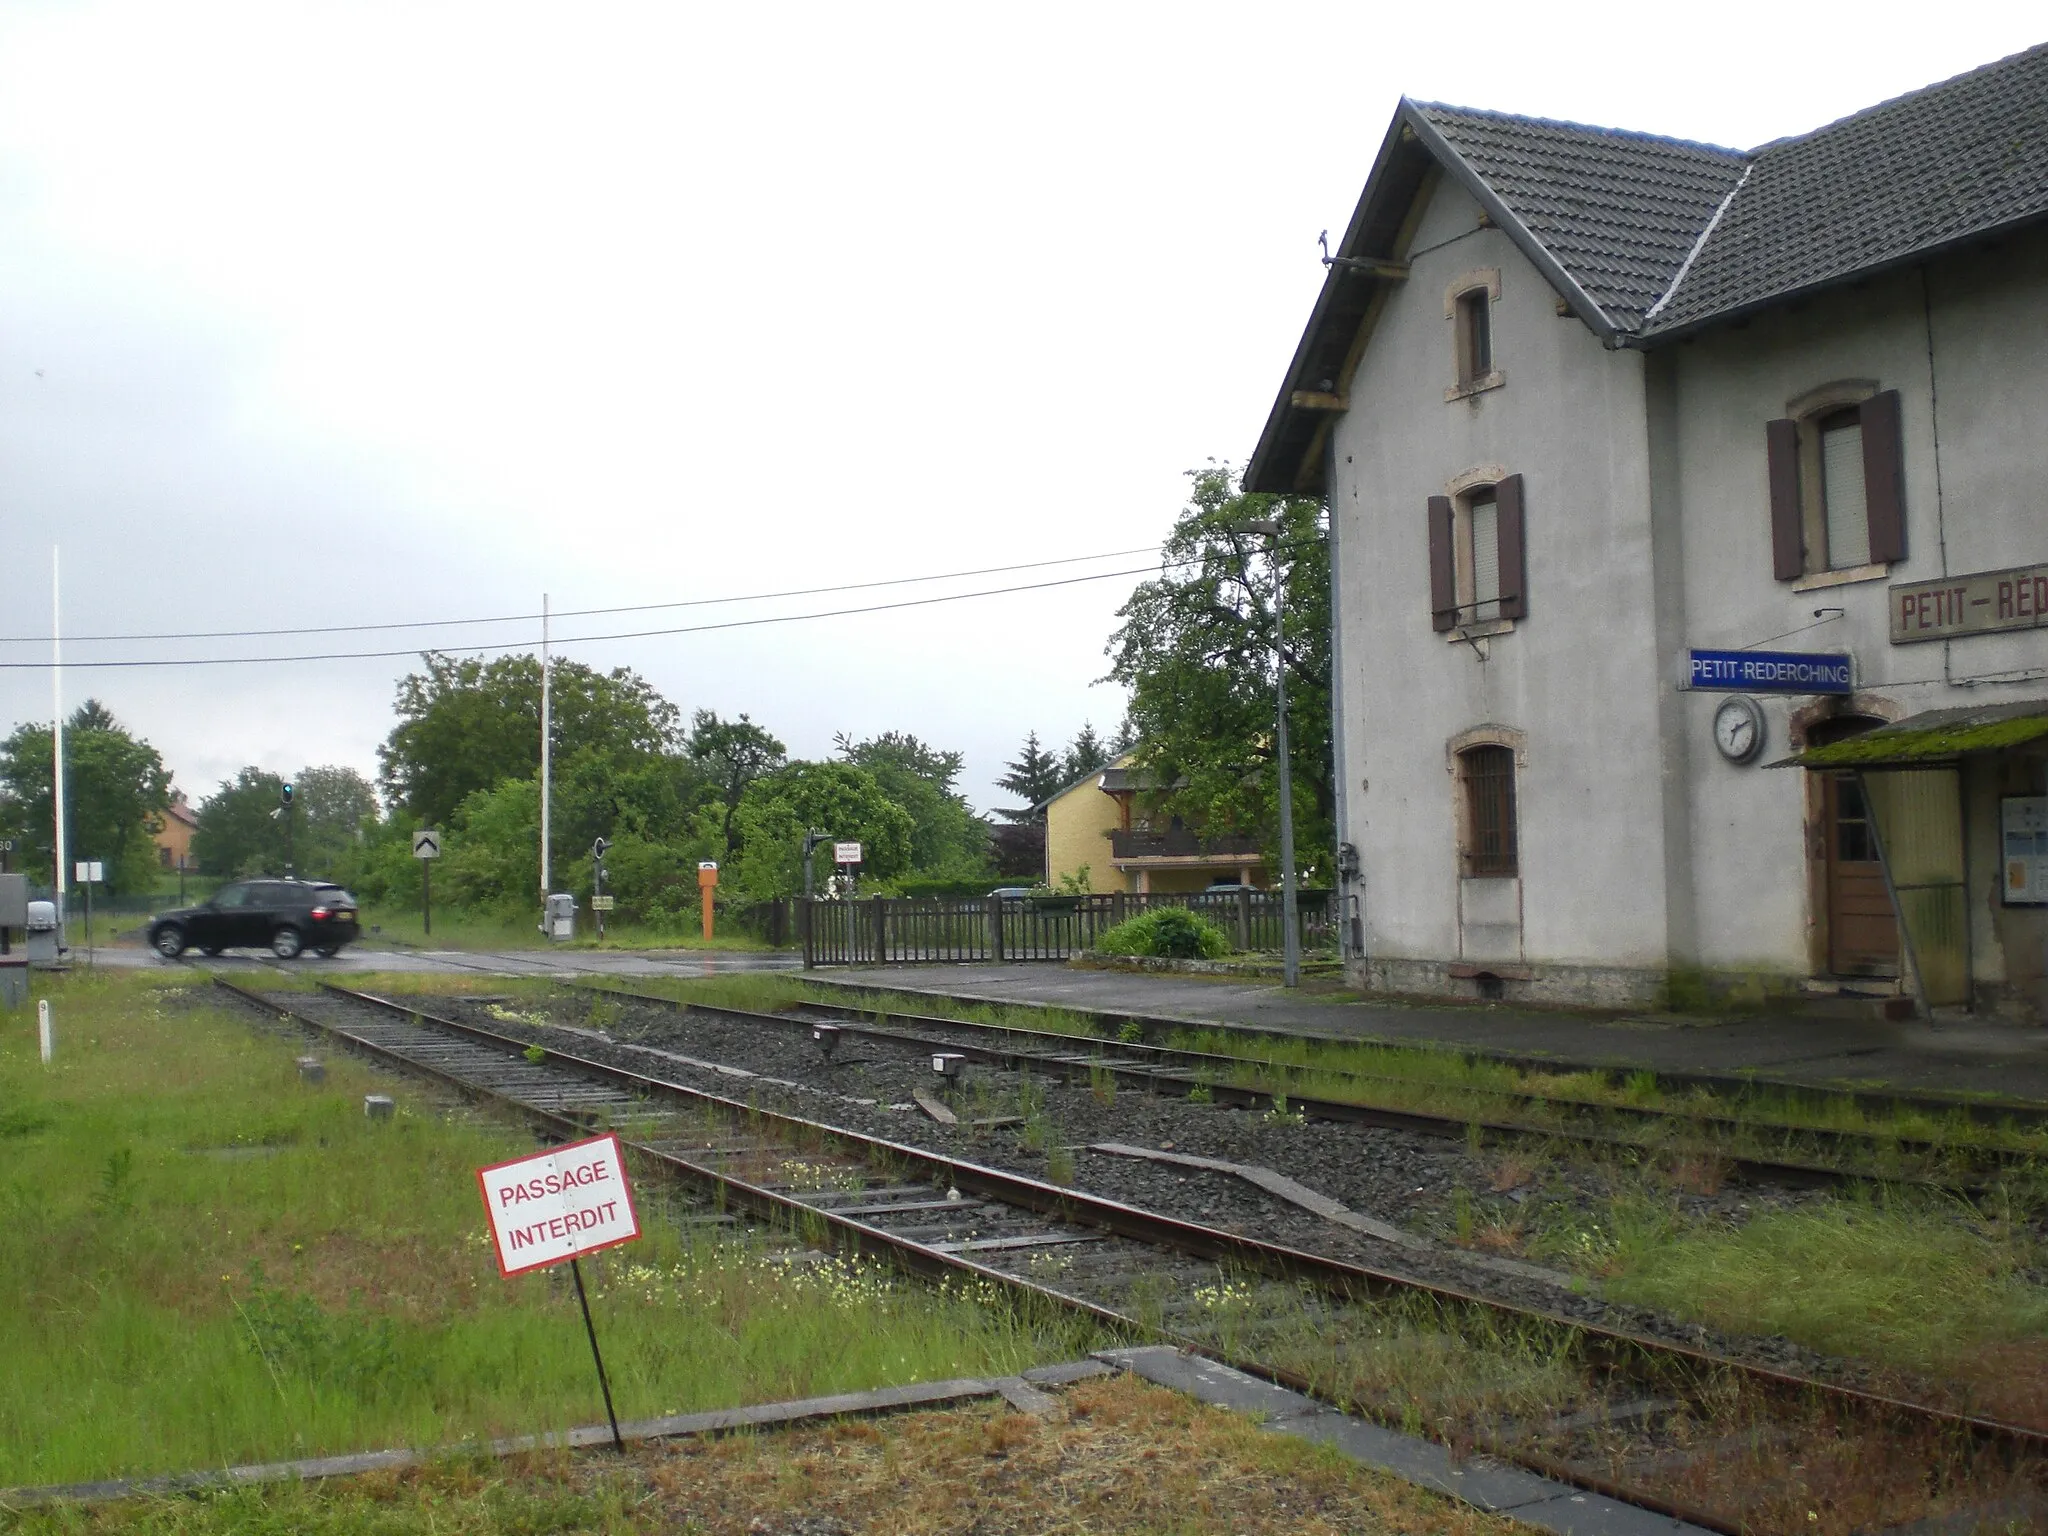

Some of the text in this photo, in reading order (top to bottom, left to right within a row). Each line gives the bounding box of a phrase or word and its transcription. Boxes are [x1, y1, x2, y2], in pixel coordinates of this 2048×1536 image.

[1691, 659, 1849, 684] PETIT-REDERCHING
[499, 1160, 609, 1208] PASSAGE
[508, 1201, 617, 1250] INTERDIT
